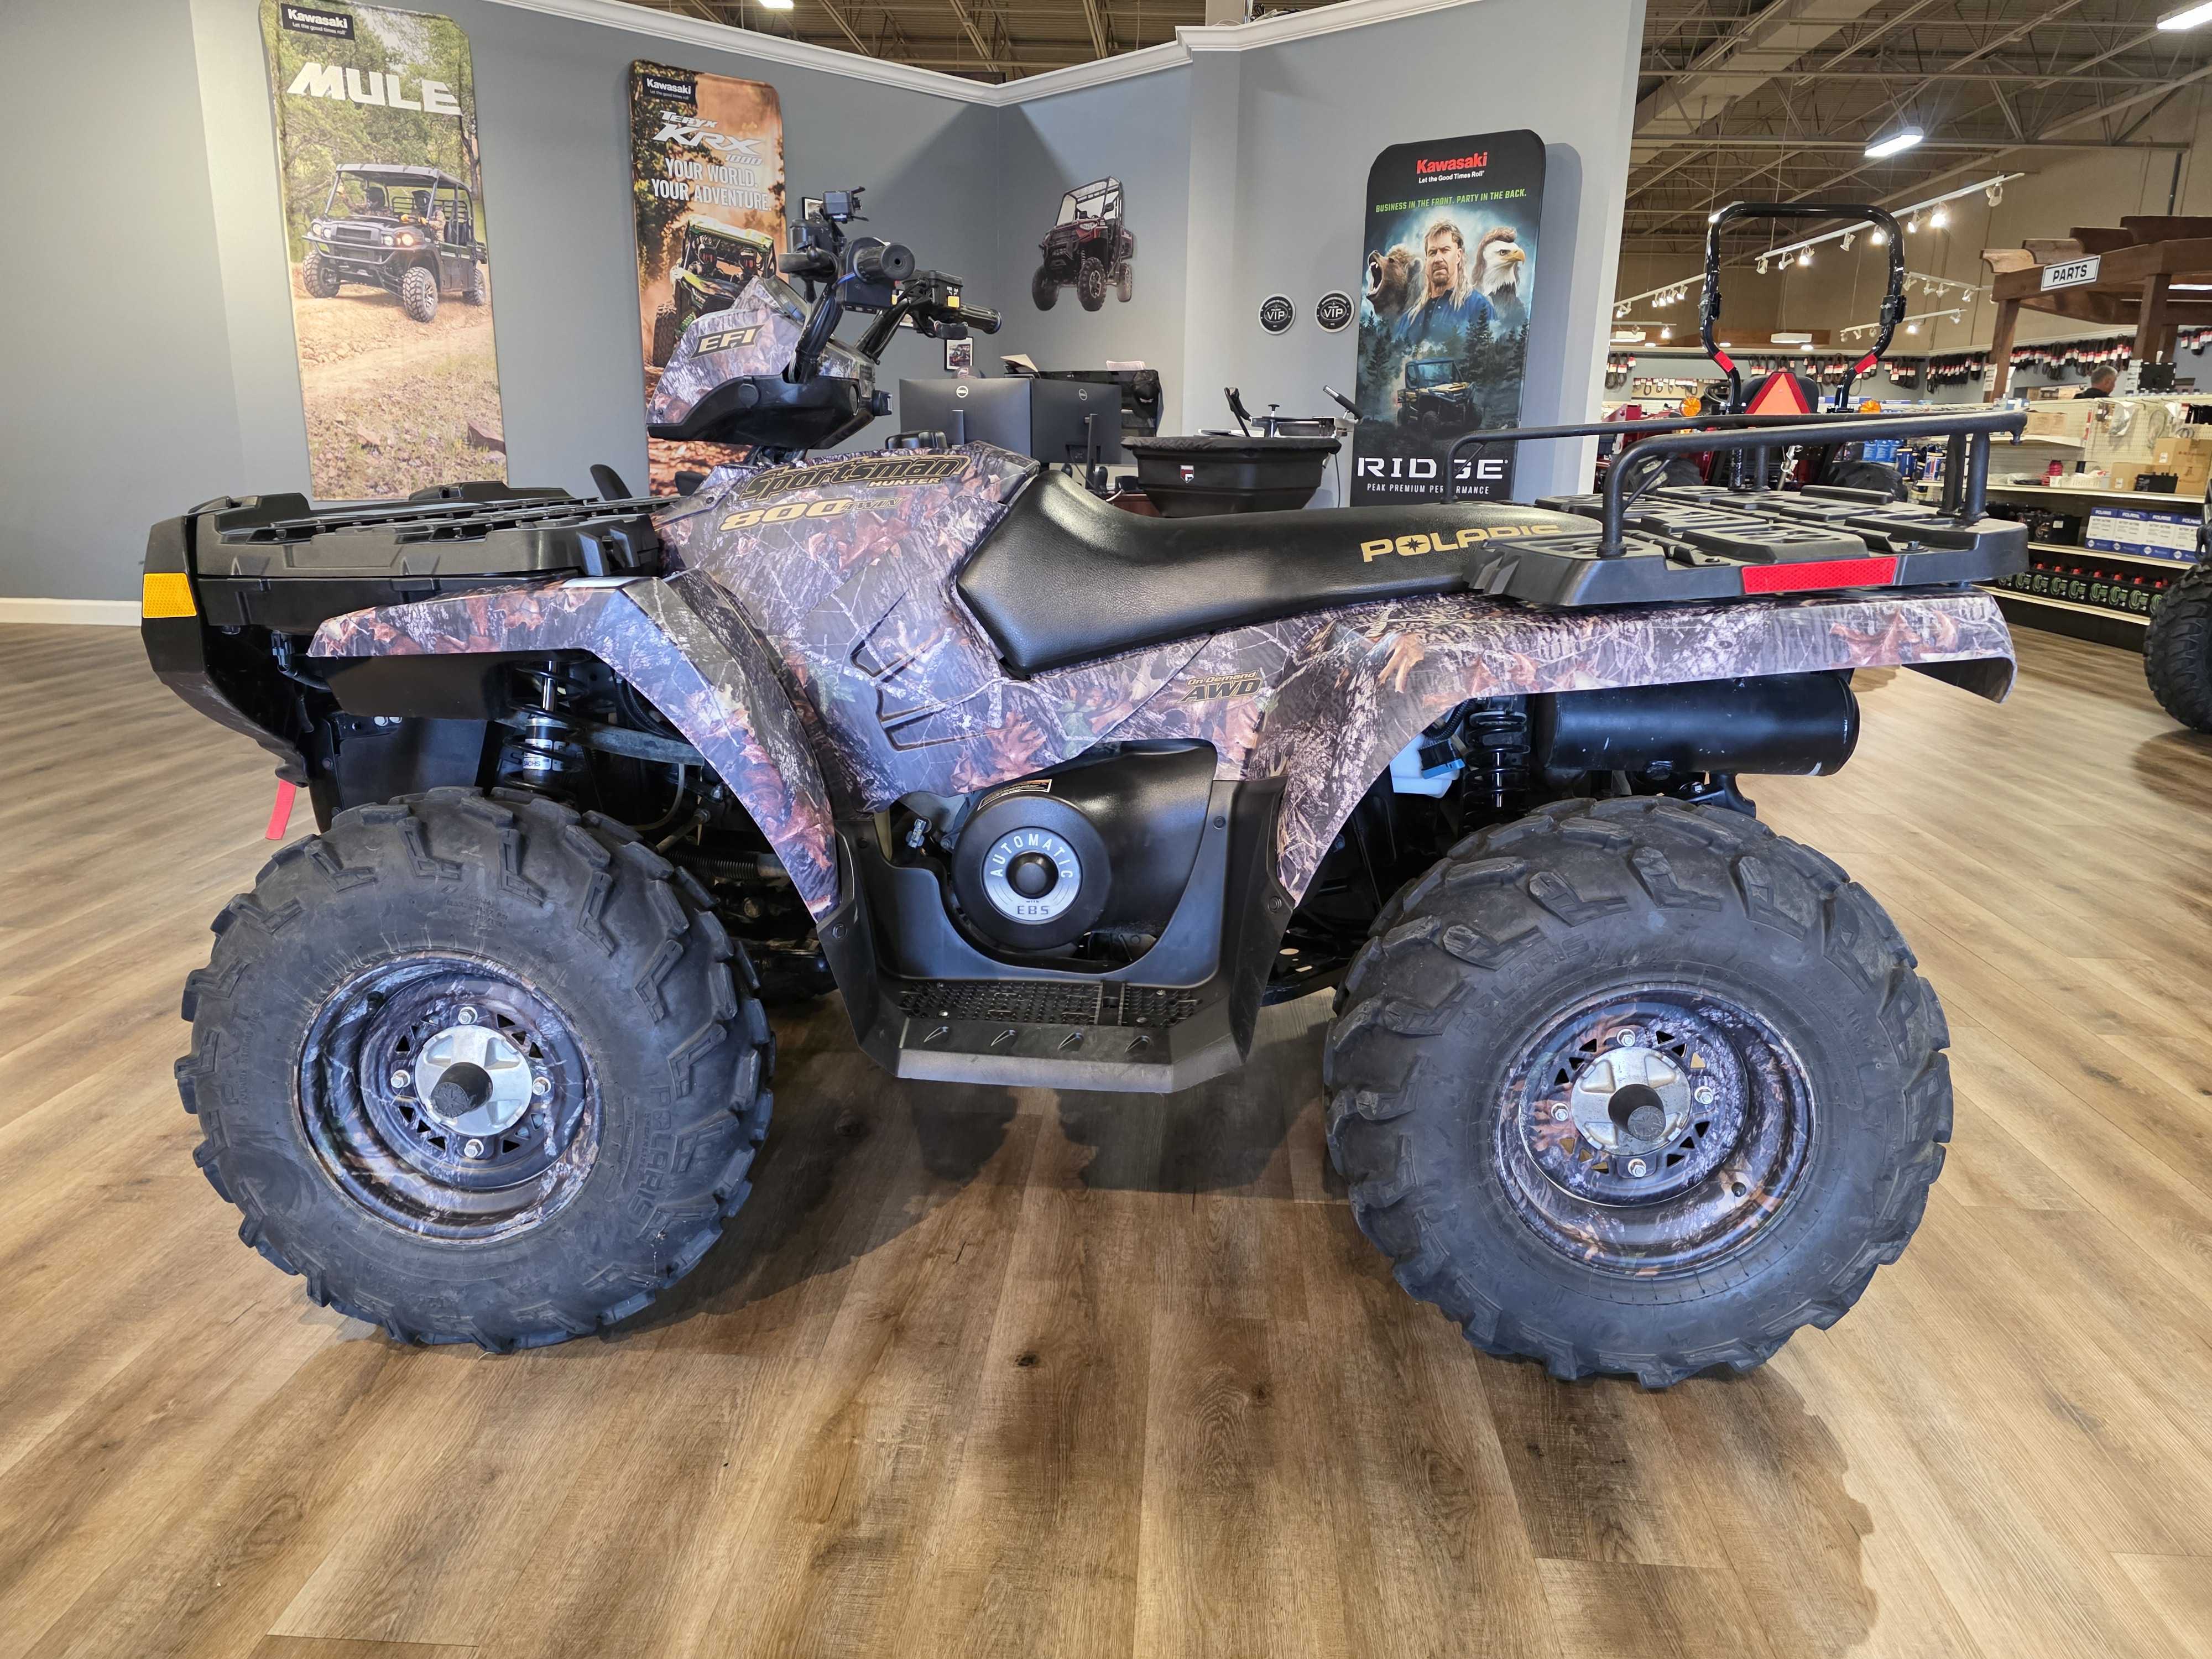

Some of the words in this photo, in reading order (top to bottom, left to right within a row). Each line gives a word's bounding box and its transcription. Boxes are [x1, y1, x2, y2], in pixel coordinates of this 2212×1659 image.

[288, 8, 348, 29] Kawasaki
[287, 62, 462, 115] MULE
[646, 78, 691, 95] Kawasaki
[653, 122, 763, 155] KRX
[726, 154, 763, 165] 1000
[1416, 152, 1488, 174] Kawasaki
[665, 158, 703, 180] YOUR
[707, 165, 758, 187] WORLD.
[651, 179, 690, 201] YOUR
[693, 185, 772, 211] ADVENTURE.
[1376, 202, 1407, 212] BUSINESS
[1408, 201, 1416, 209] IN
[1417, 199, 1430, 208] THE
[1431, 196, 1454, 206] FRONT.
[1457, 194, 1479, 204] PARTY
[1480, 192, 1489, 201] IN
[1490, 191, 1504, 200] THE
[1505, 189, 1527, 199] BACK.
[2052, 264, 2088, 283] PARTS
[1266, 311, 1285, 320] VIP
[1324, 308, 1343, 318] VIP
[698, 328, 757, 353] EFI
[738, 456, 965, 502] Sportsman
[869, 477, 942, 488] HUNTER
[1389, 483, 1425, 493] PREMIUM
[1430, 485, 1489, 494] PERRMANCE
[720, 499, 847, 531] 800
[844, 498, 905, 512] TWIN
[1206, 671, 1257, 683] Demand
[1177, 678, 1261, 703] AWD
[990, 833, 1073, 878] AUTOMATIC
[1017, 905, 1050, 915] EBS
[628, 1086, 671, 1218] POLARIS
